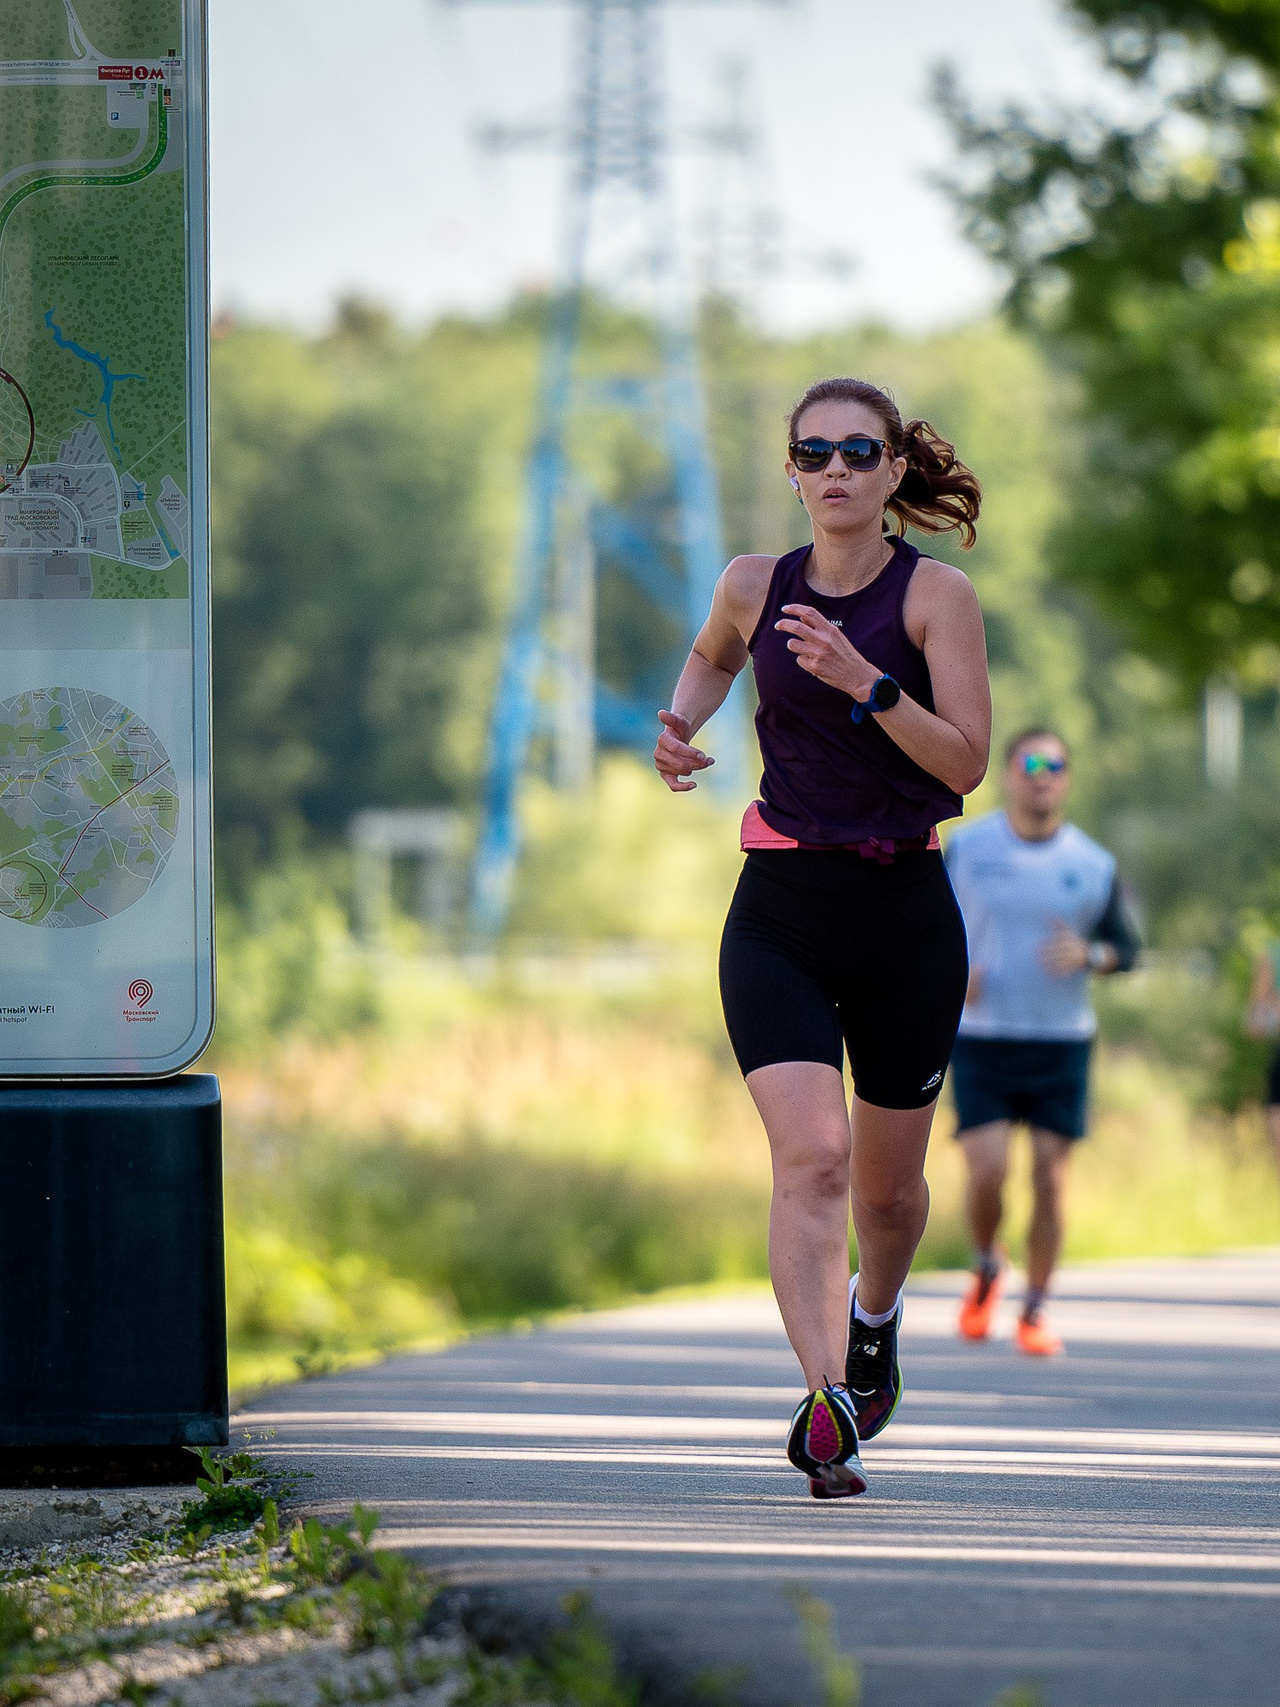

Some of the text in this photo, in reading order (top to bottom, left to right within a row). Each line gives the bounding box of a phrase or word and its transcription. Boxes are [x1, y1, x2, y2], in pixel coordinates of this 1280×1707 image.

[139, 69, 144, 78] 1
[0, 1005, 54, 1014] тный Wi-Fi
